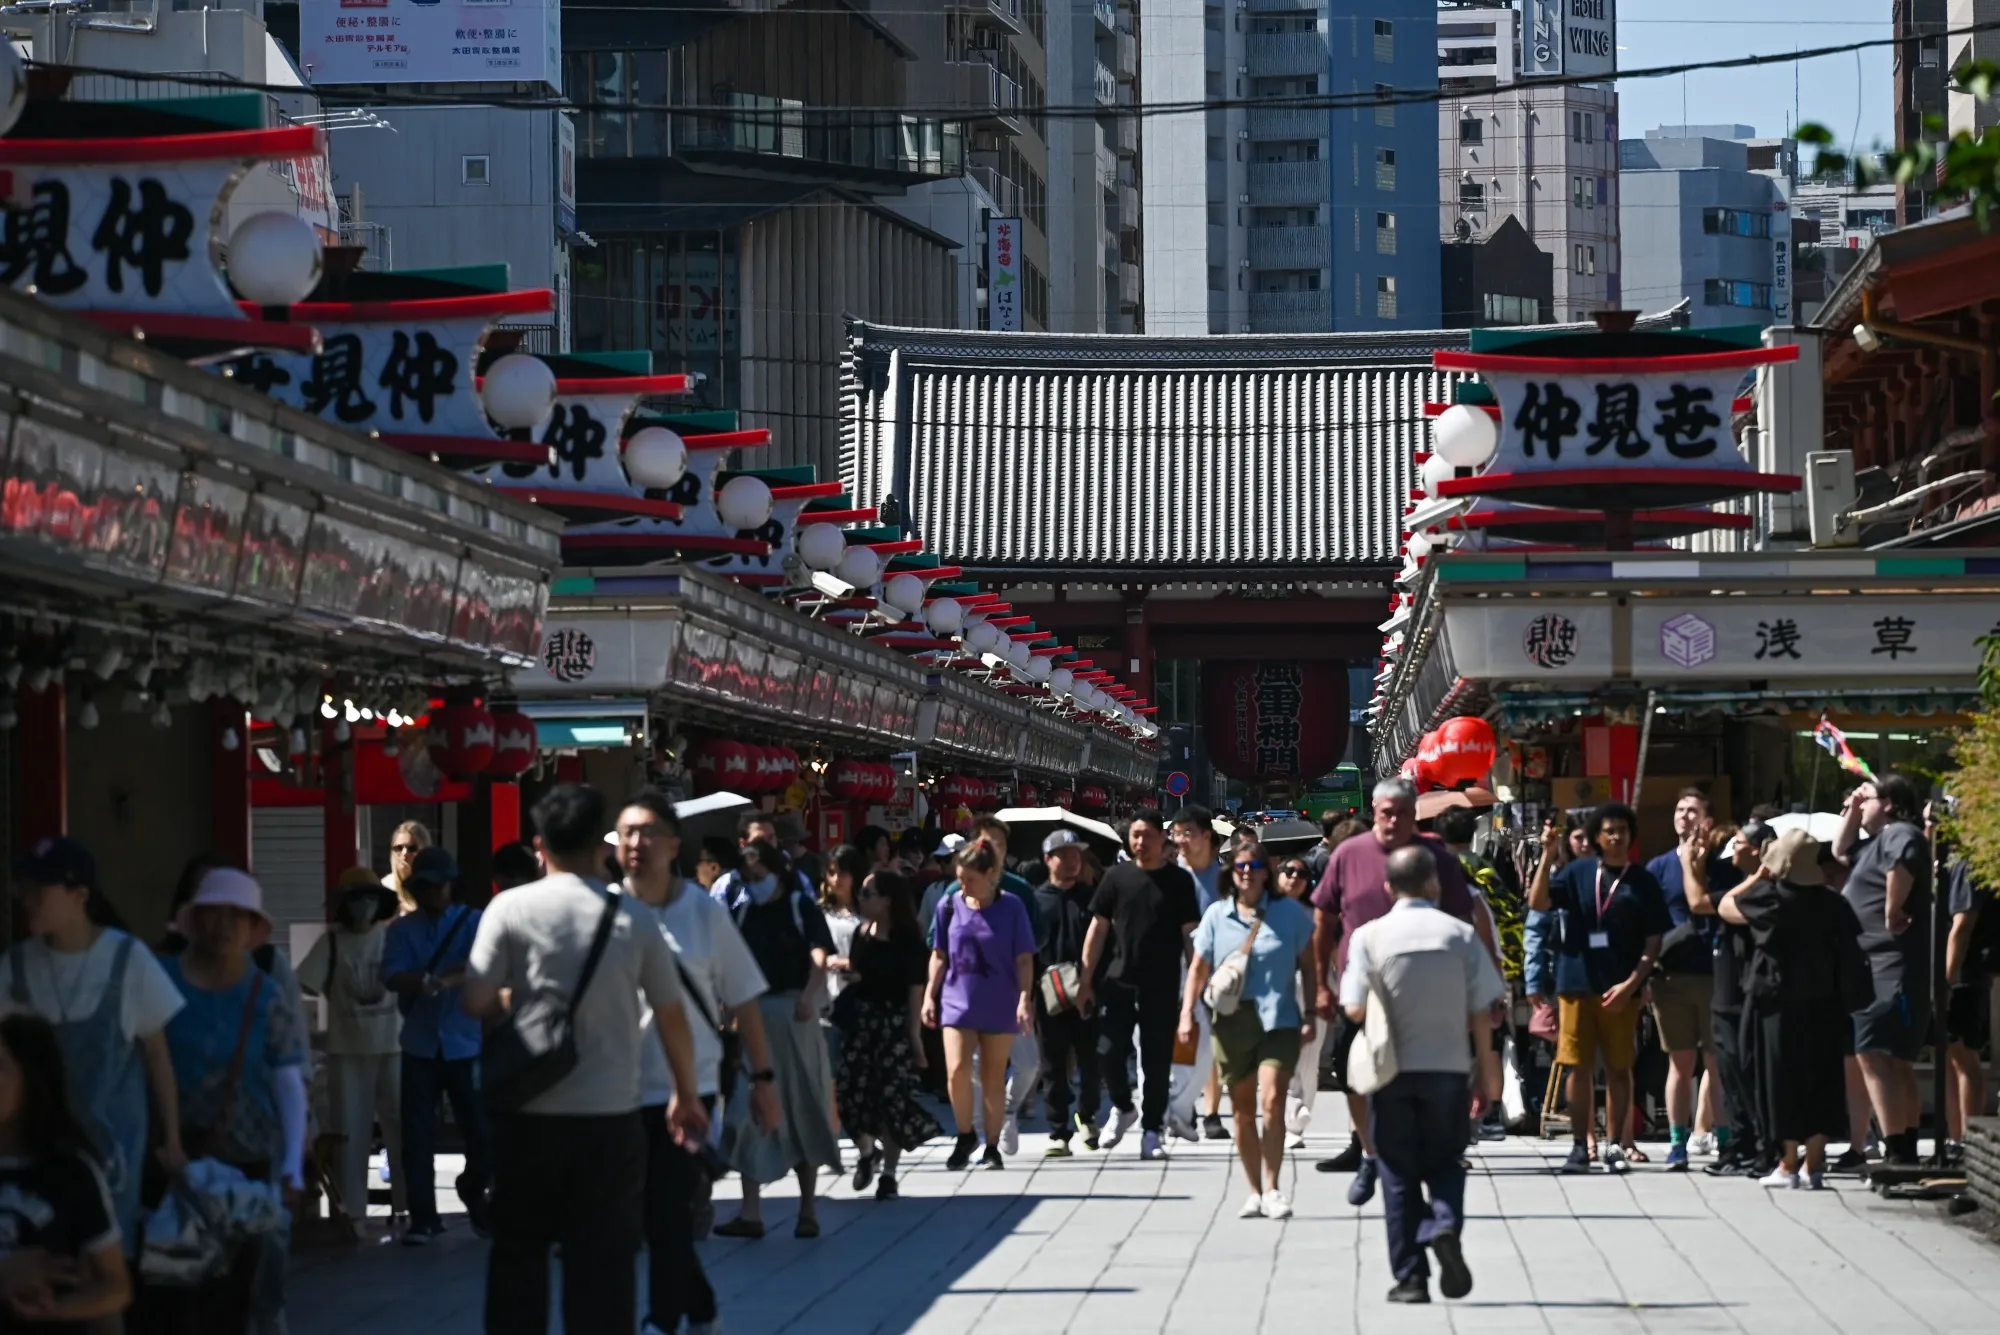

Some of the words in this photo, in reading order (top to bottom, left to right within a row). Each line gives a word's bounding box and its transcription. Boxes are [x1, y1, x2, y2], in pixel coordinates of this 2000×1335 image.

[1533, 0, 1551, 62] ING
[1571, 0, 1605, 20] HOTEL
[1569, 27, 1610, 56] WING
[998, 223, 1012, 267] 北海道
[1775, 241, 1787, 288] 株式会社
[1513, 381, 1722, 460] 仲見世
